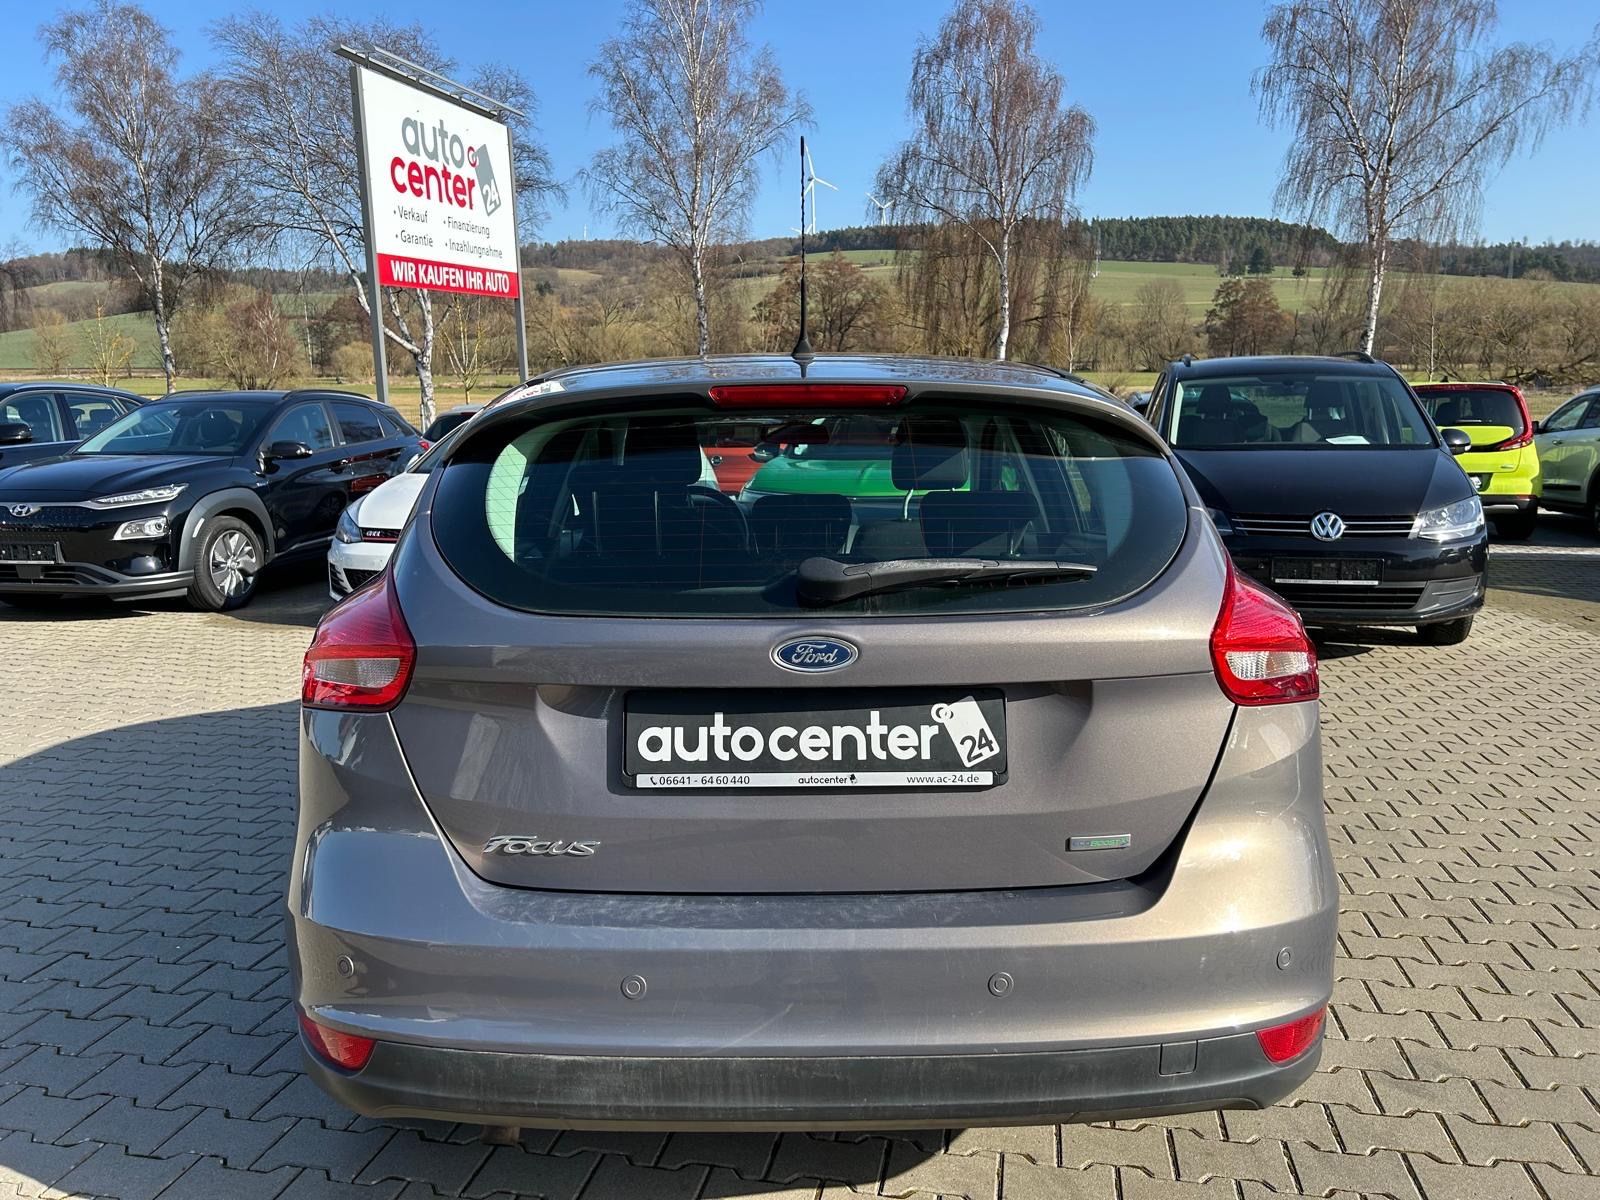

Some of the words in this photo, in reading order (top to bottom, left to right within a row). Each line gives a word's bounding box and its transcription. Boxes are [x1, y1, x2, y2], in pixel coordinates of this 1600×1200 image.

[401, 116, 464, 169] auto
[390, 156, 475, 210] center
[482, 178, 501, 211] 24
[398, 205, 428, 223] Verkauf
[400, 229, 434, 247] Garantie
[447, 216, 490, 239] Finanzierung
[449, 238, 503, 259] Inzahlungnahme
[390, 260, 416, 282] WIR
[418, 264, 464, 288] KAUFEN
[465, 270, 485, 291] IHR
[485, 271, 510, 293] AUTO
[791, 643, 839, 663] Ford
[637, 711, 939, 762] autocenter
[959, 727, 995, 763] 24
[659, 775, 692, 785] 06641
[798, 774, 848, 785] autocenter
[906, 774, 980, 784] www.ac-24.de
